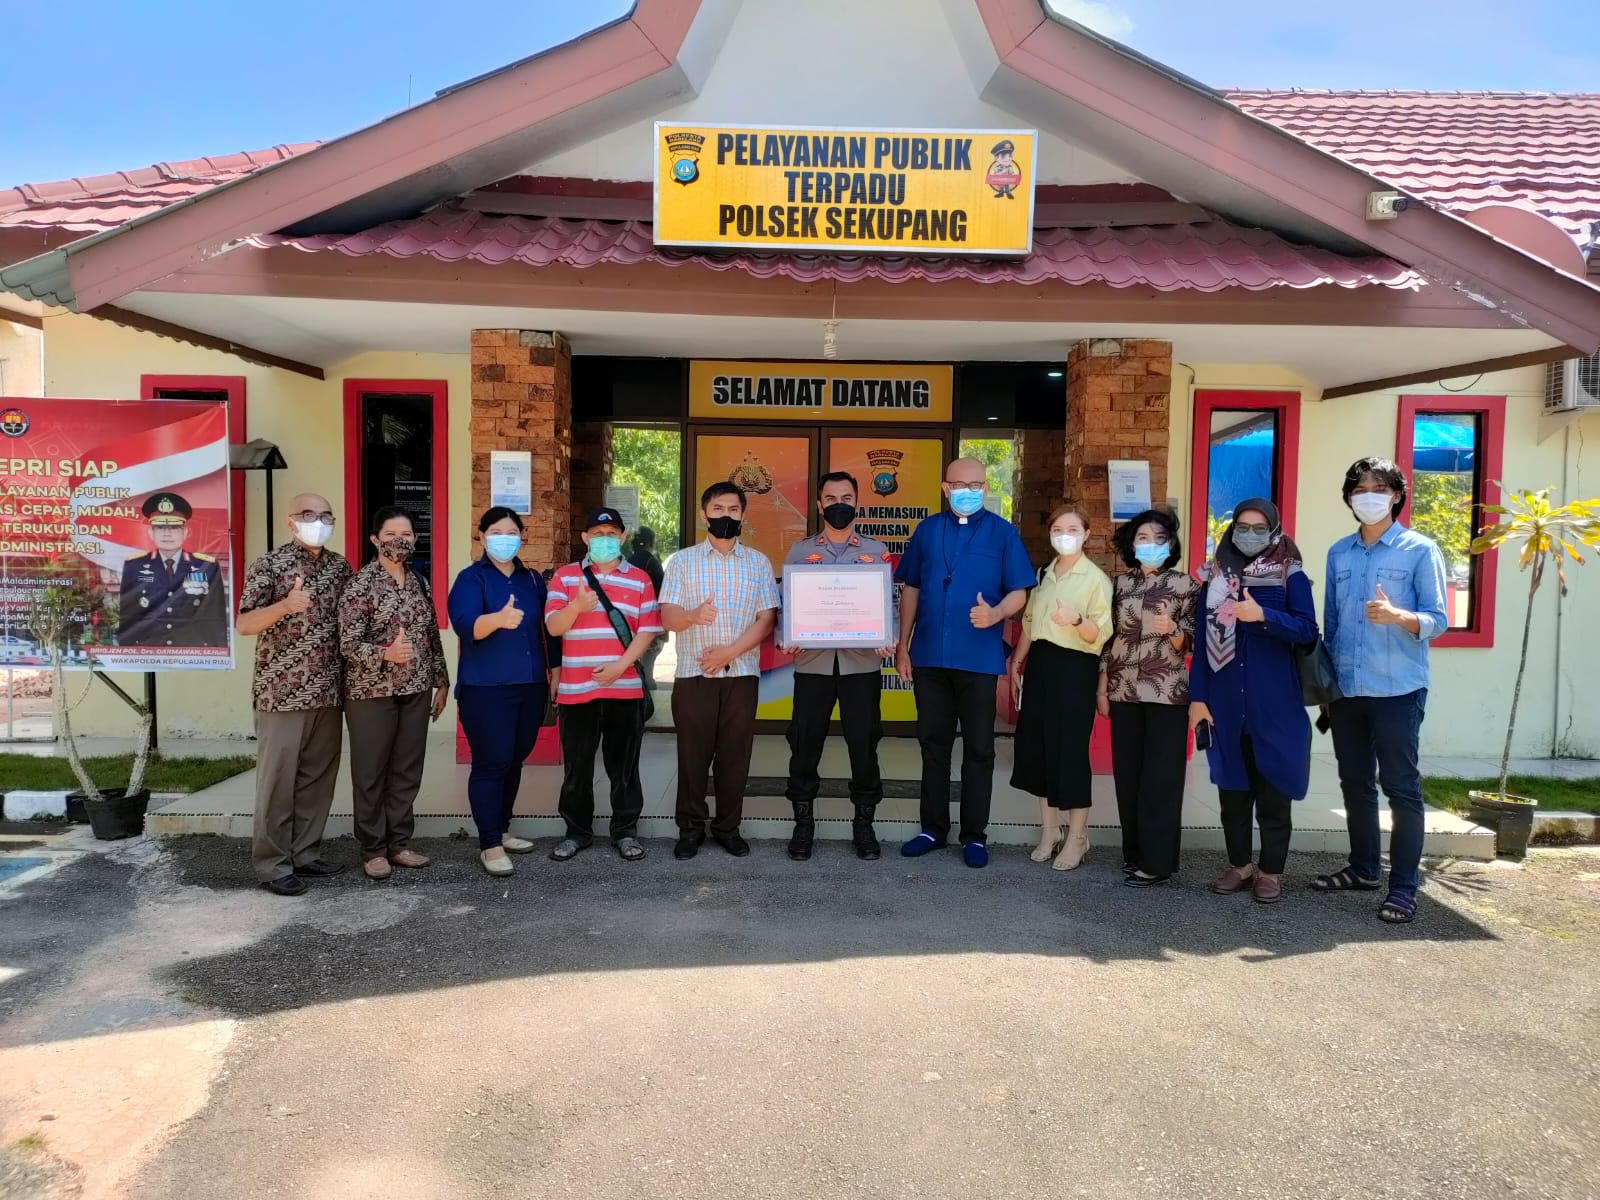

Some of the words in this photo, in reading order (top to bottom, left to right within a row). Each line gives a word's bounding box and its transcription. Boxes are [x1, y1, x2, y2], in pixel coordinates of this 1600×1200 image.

[717, 133, 866, 168] PELAYANAN
[874, 137, 971, 170] PUBLIK
[784, 171, 905, 205] TERPADU
[718, 205, 818, 238] POLSEK
[826, 207, 967, 242] SEKUPANG
[713, 376, 826, 406] SELAMAT
[833, 380, 929, 408] DATANG
[58, 460, 118, 478] SIAP
[75, 487, 130, 499] PUBLIK
[21, 505, 75, 517] CEPAT,
[78, 506, 139, 519] MUDAH,
[869, 507, 928, 519] MEMASUKI
[2, 522, 75, 535] TERUKUR
[78, 524, 112, 536] DAN
[854, 524, 909, 537] KAWASAN
[0, 541, 104, 554] DMINISTRASI.
[163, 658, 210, 666] KEPULAUAN
